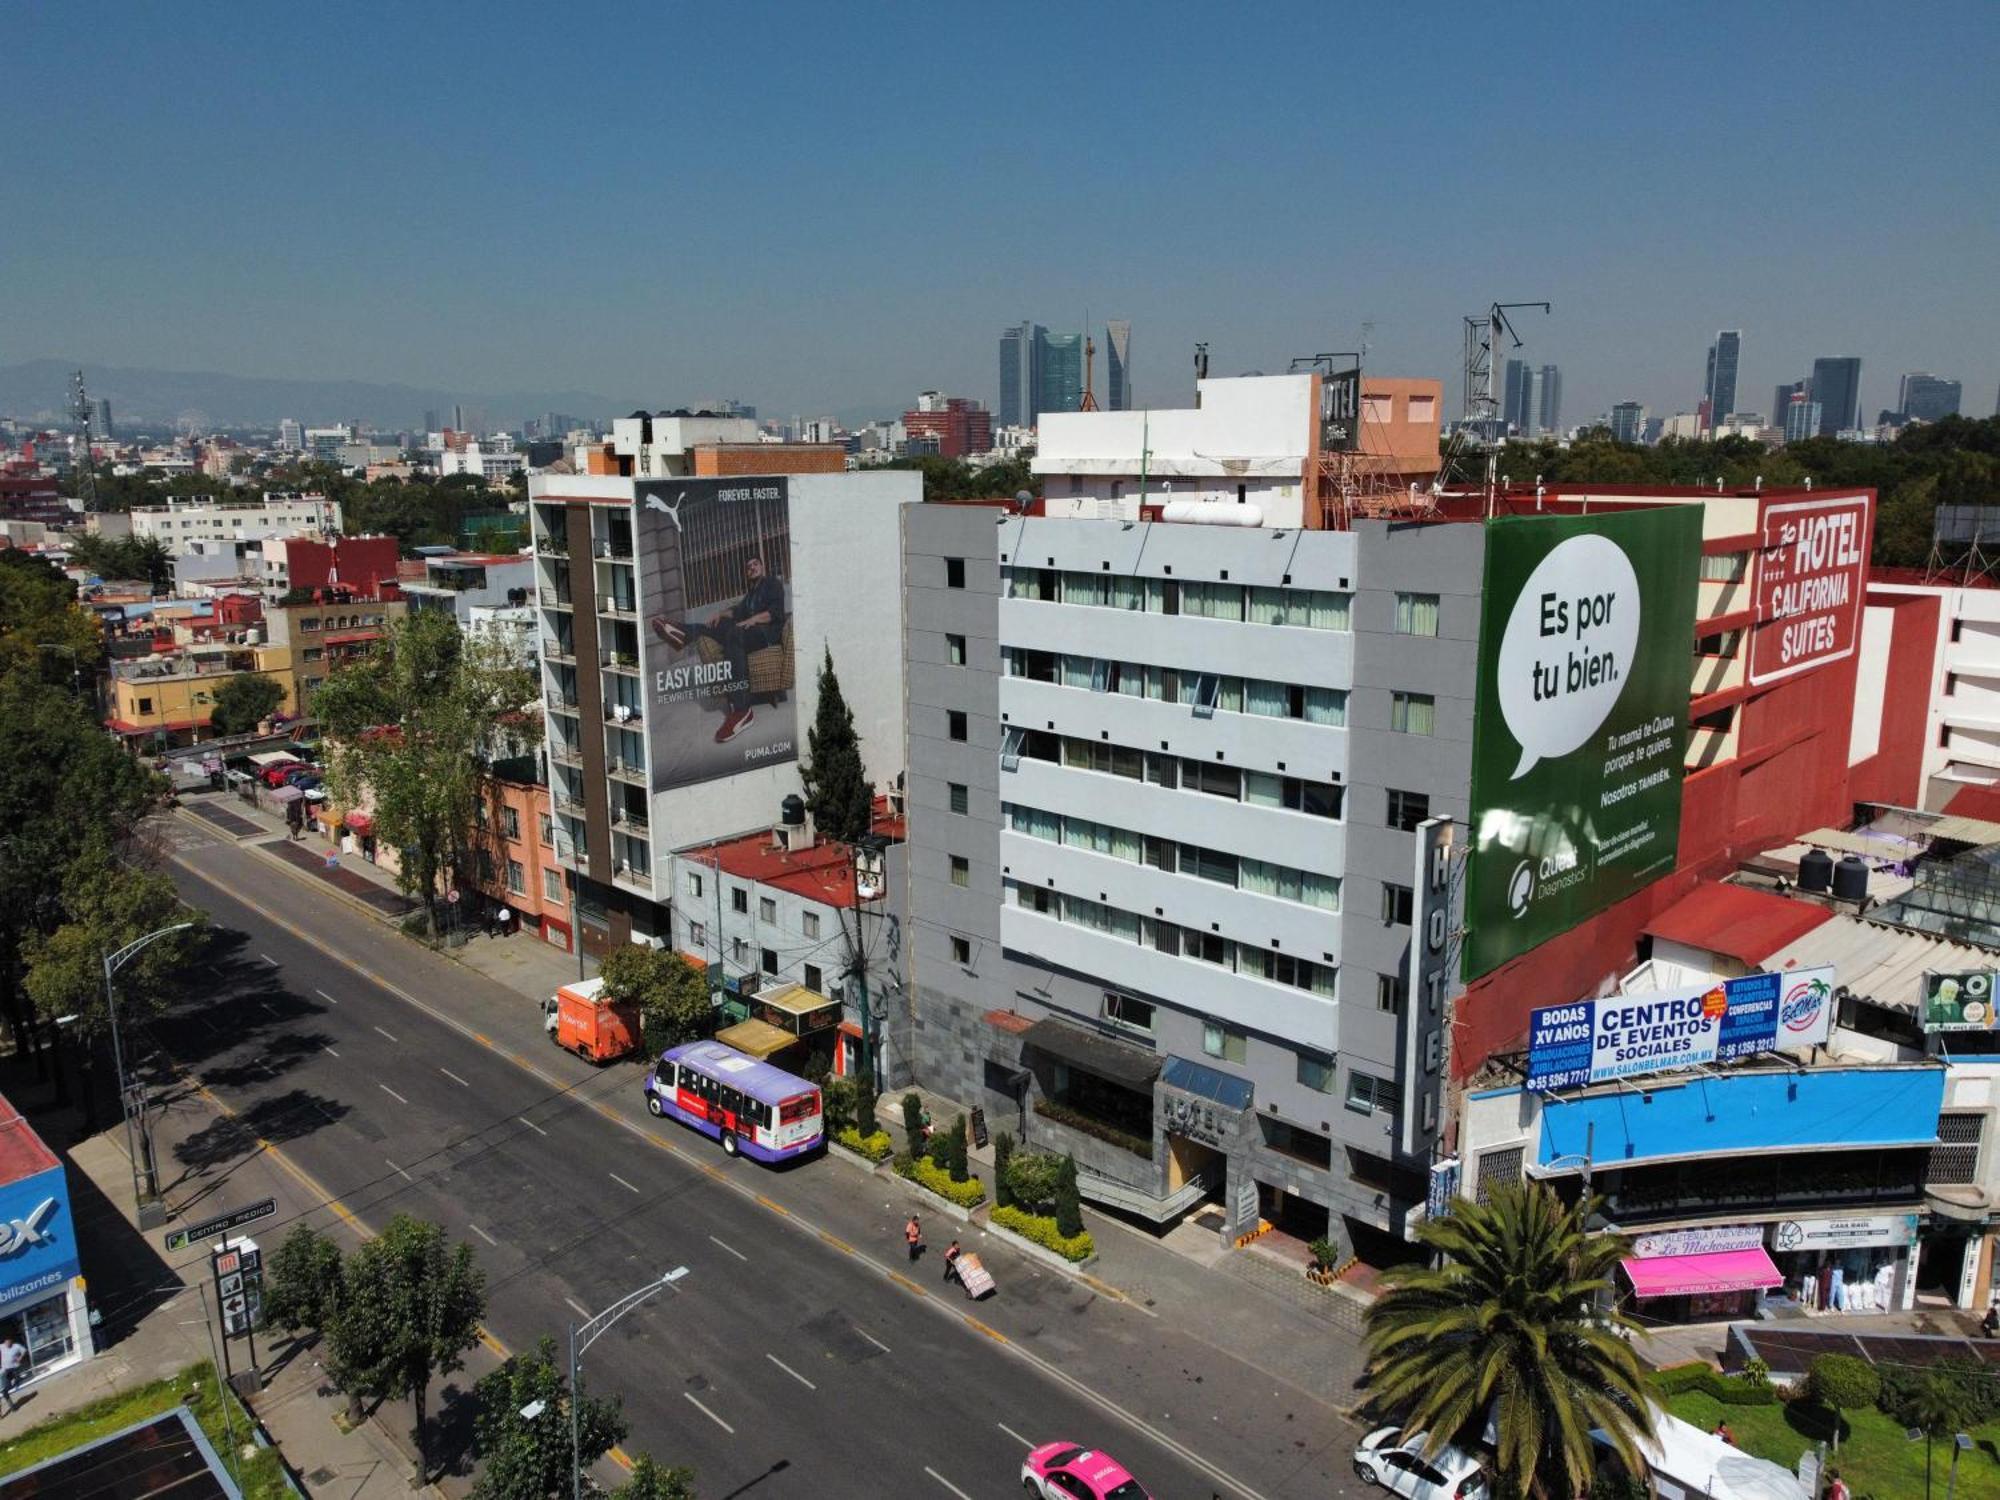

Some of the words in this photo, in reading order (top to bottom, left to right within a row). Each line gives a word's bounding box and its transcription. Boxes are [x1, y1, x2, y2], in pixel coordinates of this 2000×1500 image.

[1794, 511, 1860, 575] HOTEL
[1771, 572, 1850, 620] CALIFORNIA
[1539, 592, 1568, 637] Es
[1576, 592, 1616, 641] por
[1780, 614, 1836, 664] SUITES
[656, 666, 690, 692] EASY
[694, 660, 733, 686] RIDER
[1532, 660, 1559, 702] tu
[1566, 645, 1619, 694] bien.
[656, 690, 694, 705] REWRITE
[696, 688, 711, 699] THE
[712, 679, 749, 694] CLASSICS
[744, 741, 791, 760] PUMA.COM
[1608, 735, 1617, 751] Tu
[1618, 726, 1642, 747] mamá
[1643, 723, 1652, 738] te
[1603, 754, 1635, 779] porque
[1636, 746, 1645, 761] te
[1600, 782, 1638, 808] Nosotros
[1539, 846, 1578, 880] Quest
[1421, 843, 1450, 1136] HOTEL
[1542, 1006, 1586, 1026] BODAS
[1601, 996, 1703, 1032] CENTRO
[1535, 1029, 1554, 1045] XV
[1554, 1023, 1590, 1042] AÑOS
[1596, 1032, 1621, 1050] DE
[1627, 1018, 1712, 1045] EVENTOS
[1615, 1038, 1692, 1062] SOCIALES
[1536, 1075, 1547, 1090] 55
[1570, 1068, 1590, 1084] 7717
[1593, 1050, 1714, 1079] WWW.SALONBELMAR.COM.MX
